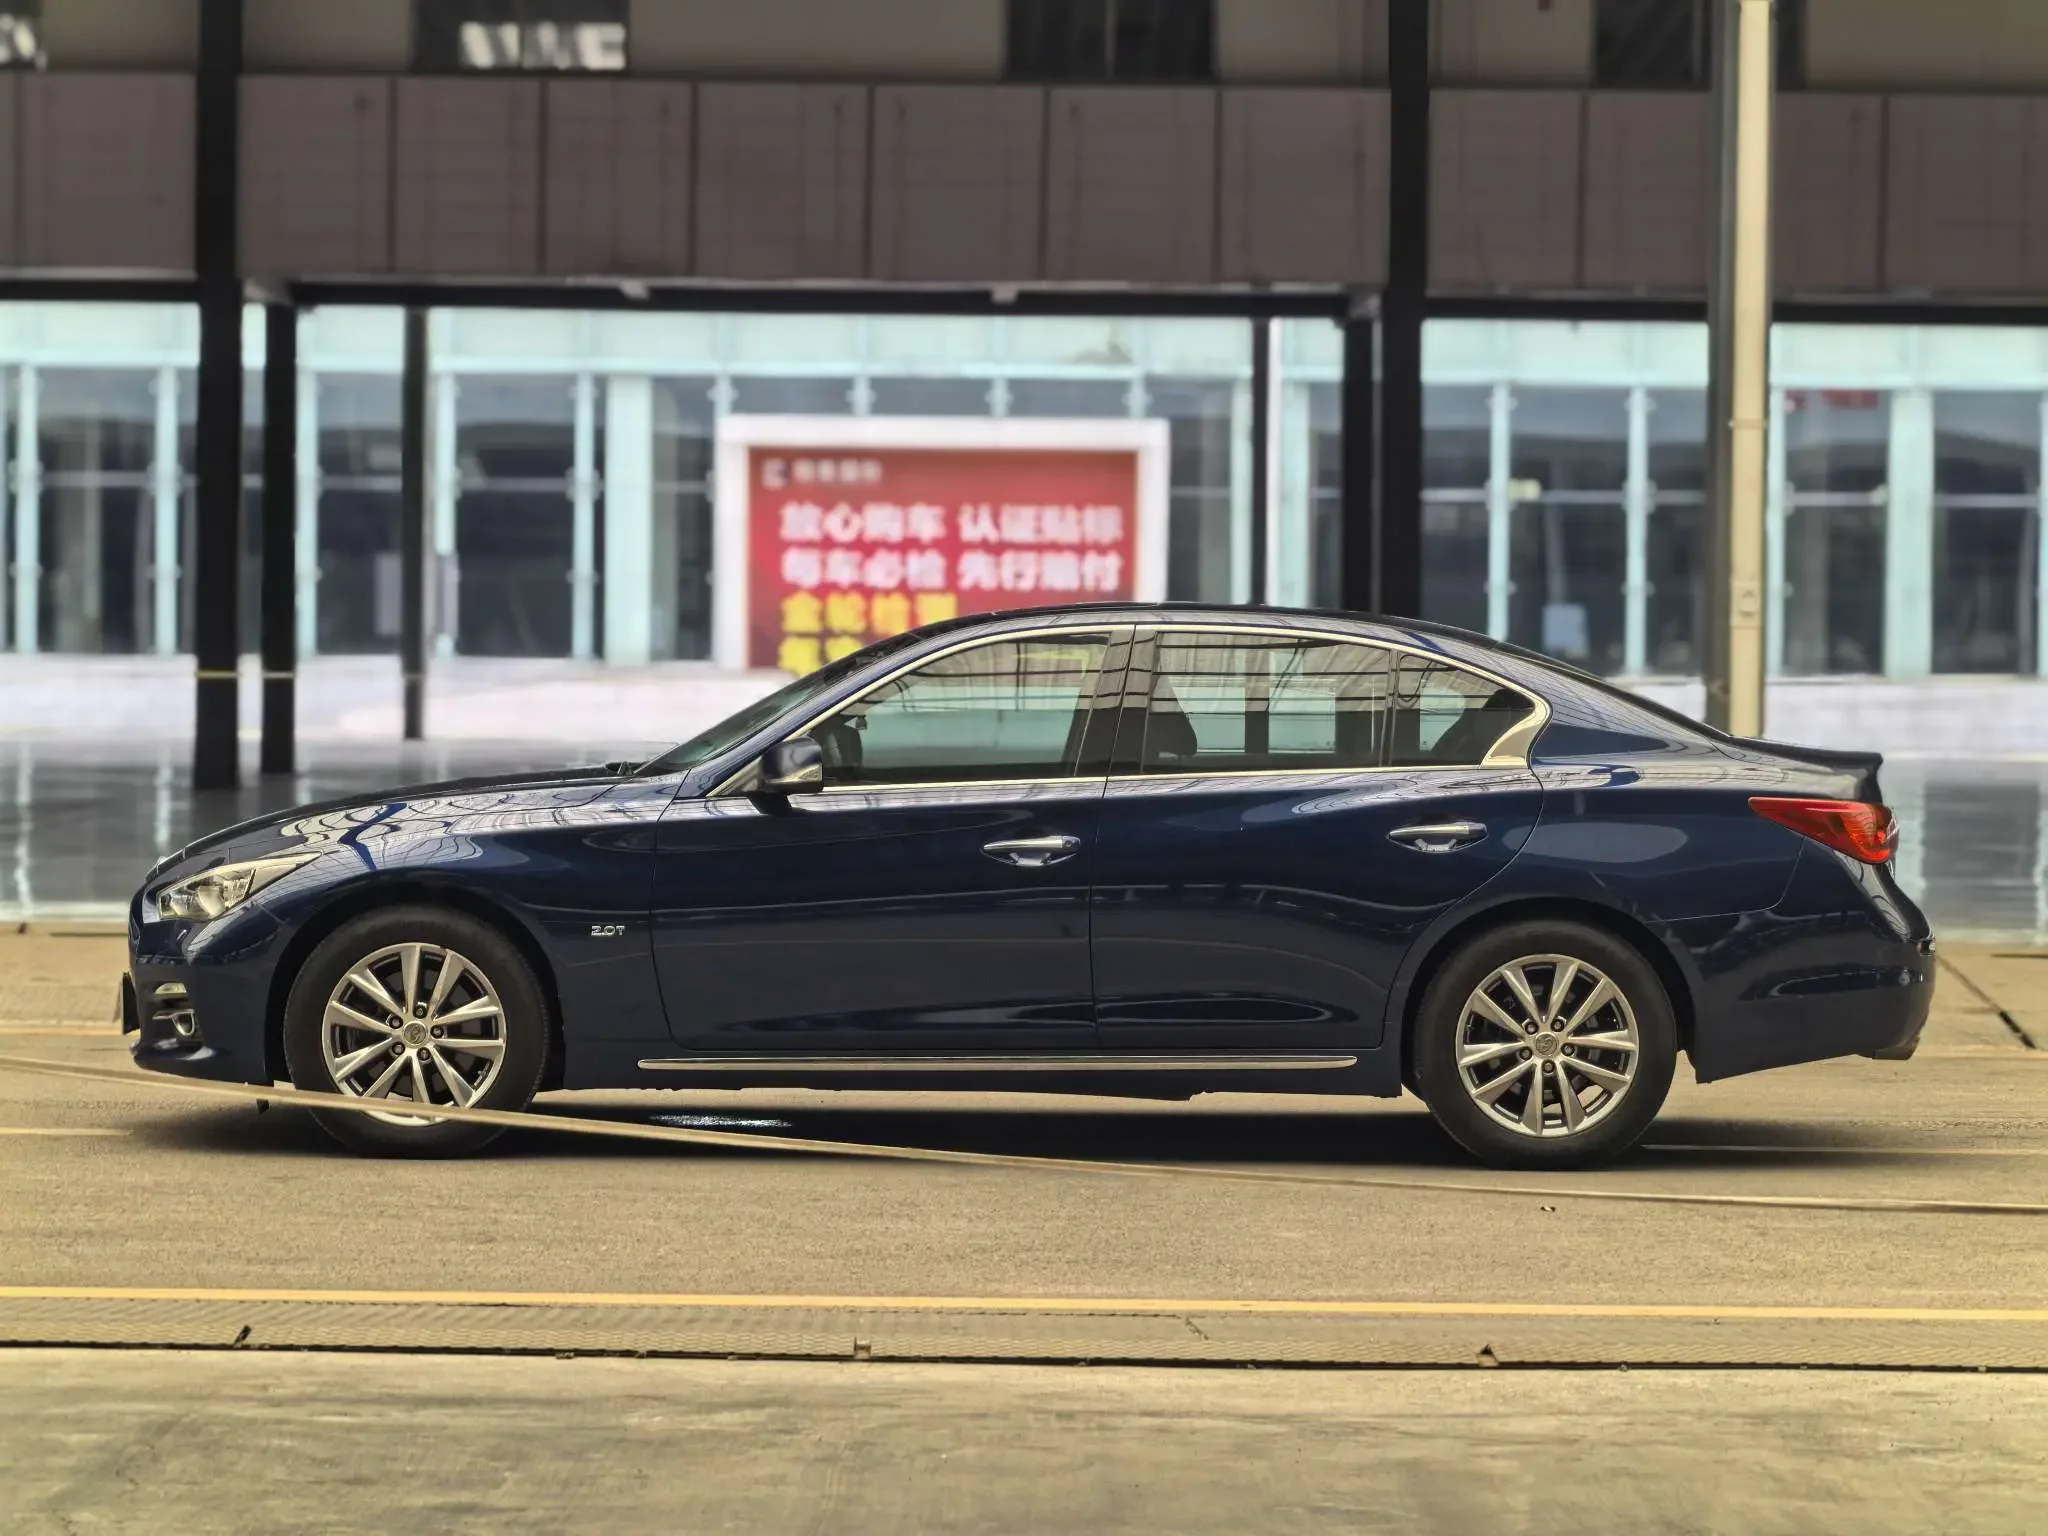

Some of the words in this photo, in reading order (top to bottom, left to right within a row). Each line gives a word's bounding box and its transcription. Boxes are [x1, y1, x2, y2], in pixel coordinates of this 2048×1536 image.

[780, 502, 945, 542] 放心购车
[781, 548, 946, 588] 每车必检
[958, 550, 1122, 591] 先行赔付
[591, 925, 625, 936] 2.0T
